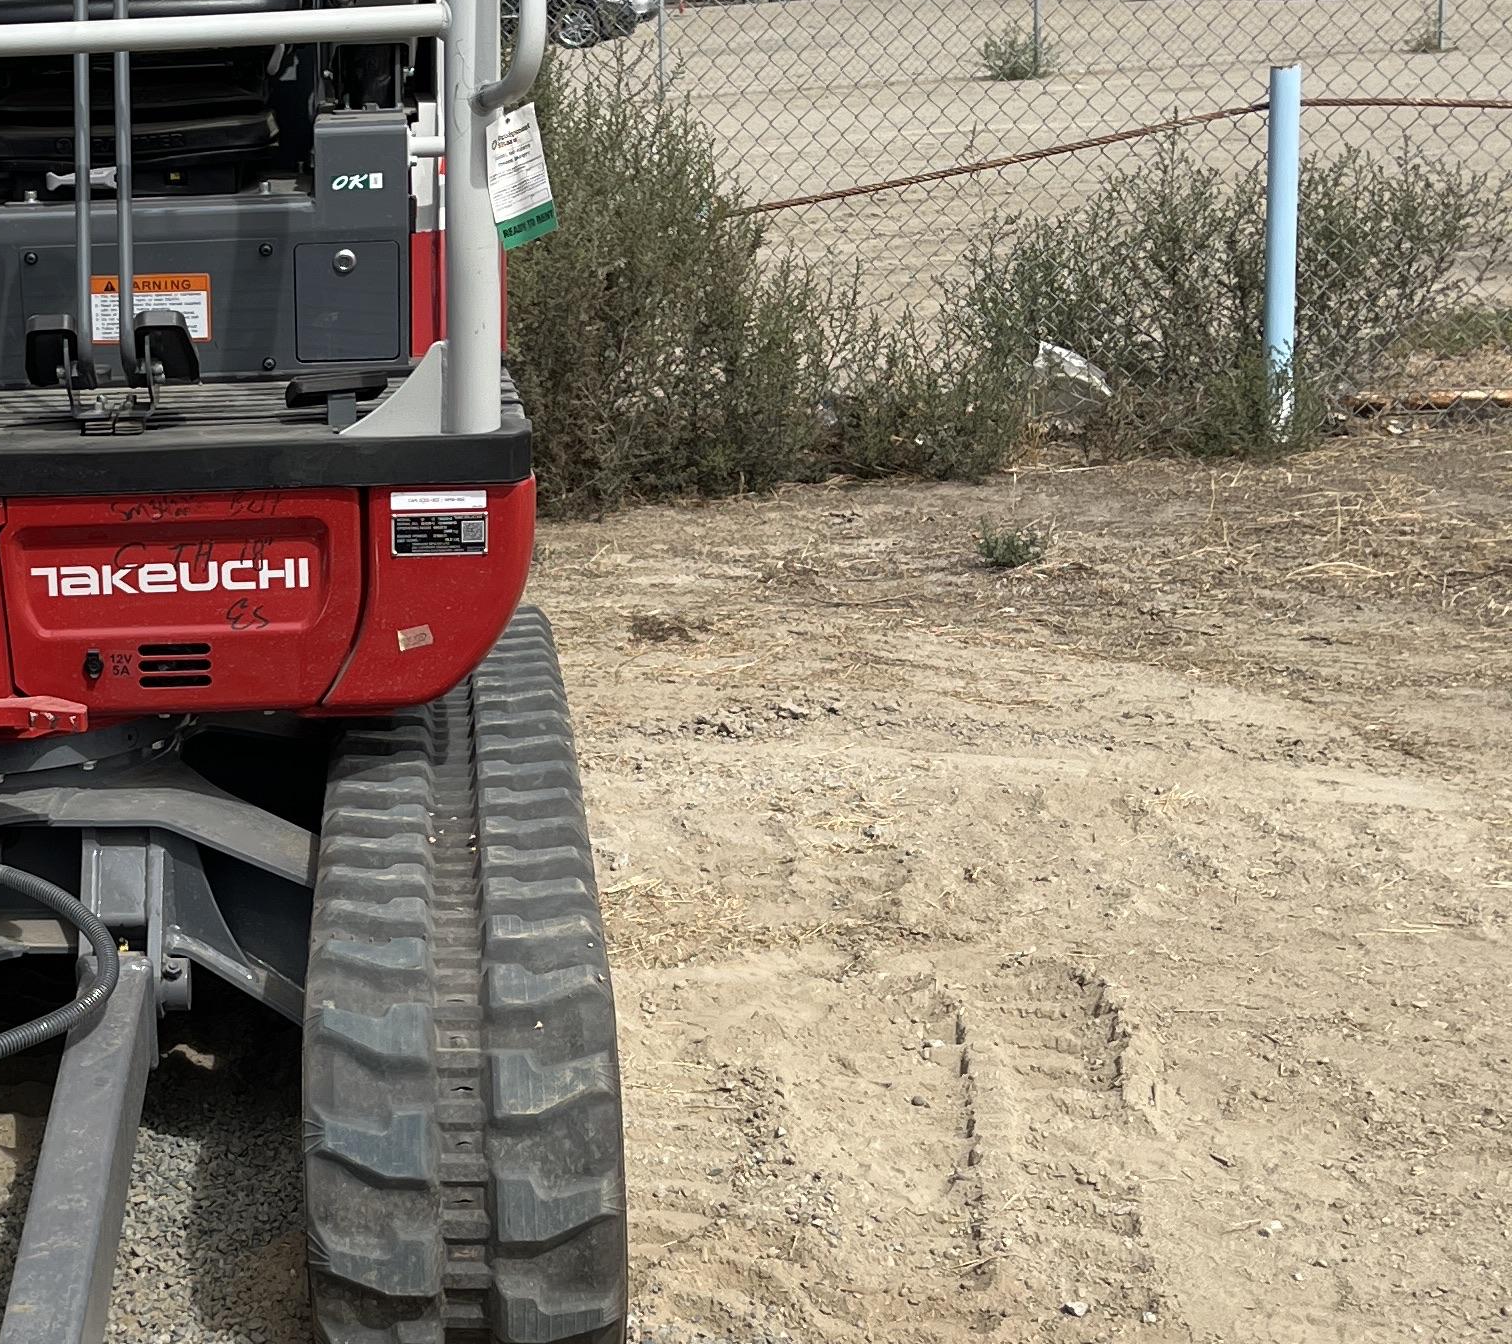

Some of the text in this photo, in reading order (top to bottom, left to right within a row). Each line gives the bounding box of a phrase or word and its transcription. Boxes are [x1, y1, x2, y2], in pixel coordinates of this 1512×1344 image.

[331, 173, 369, 191] OK
[133, 279, 192, 292] ARNING
[110, 653, 133, 664] 12V
[112, 664, 130, 676] 5A
